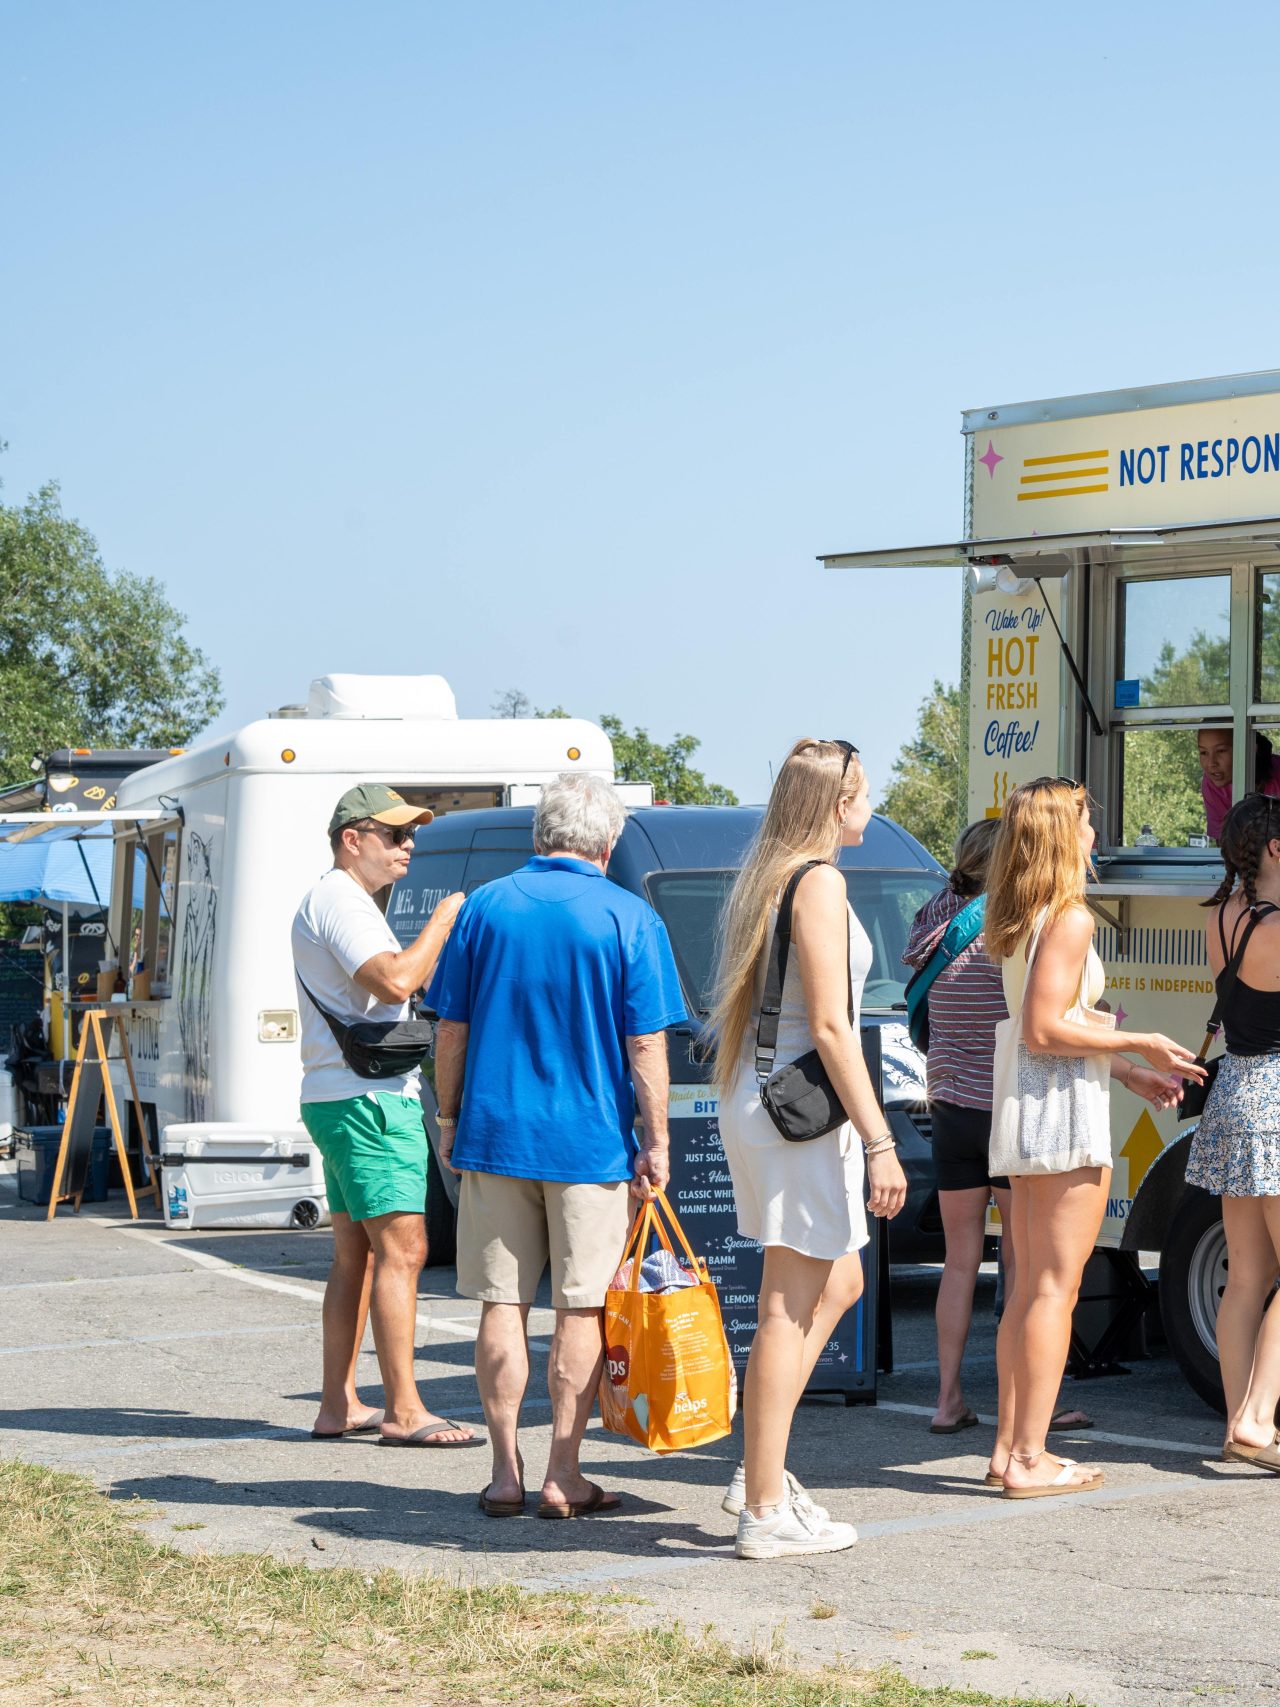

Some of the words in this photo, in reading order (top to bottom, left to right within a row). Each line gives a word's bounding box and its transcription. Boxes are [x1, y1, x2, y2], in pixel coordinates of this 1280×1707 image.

[1119, 445, 1170, 487] NOT
[985, 609, 1019, 632] Wake
[1021, 607, 1046, 633] Up!
[987, 635, 1040, 677] HOT
[986, 682, 1038, 710] FRESH
[983, 719, 1040, 758] Coffee!
[394, 888, 415, 915] MR.
[1135, 978, 1146, 991] IS
[1150, 978, 1215, 994] INDEPEND
[694, 1101, 718, 1113] BIT
[684, 1153, 704, 1162] JUST
[705, 1153, 727, 1162] SUGA
[678, 1190, 712, 1199] CLASSIC
[714, 1190, 735, 1199] WHIT
[680, 1205, 707, 1213] MAINE
[708, 1255, 736, 1265] BAMM
[725, 1294, 755, 1304] LEMON
[729, 1318, 758, 1335] Specia
[734, 1343, 752, 1354] Don
[674, 1398, 707, 1414] helps
